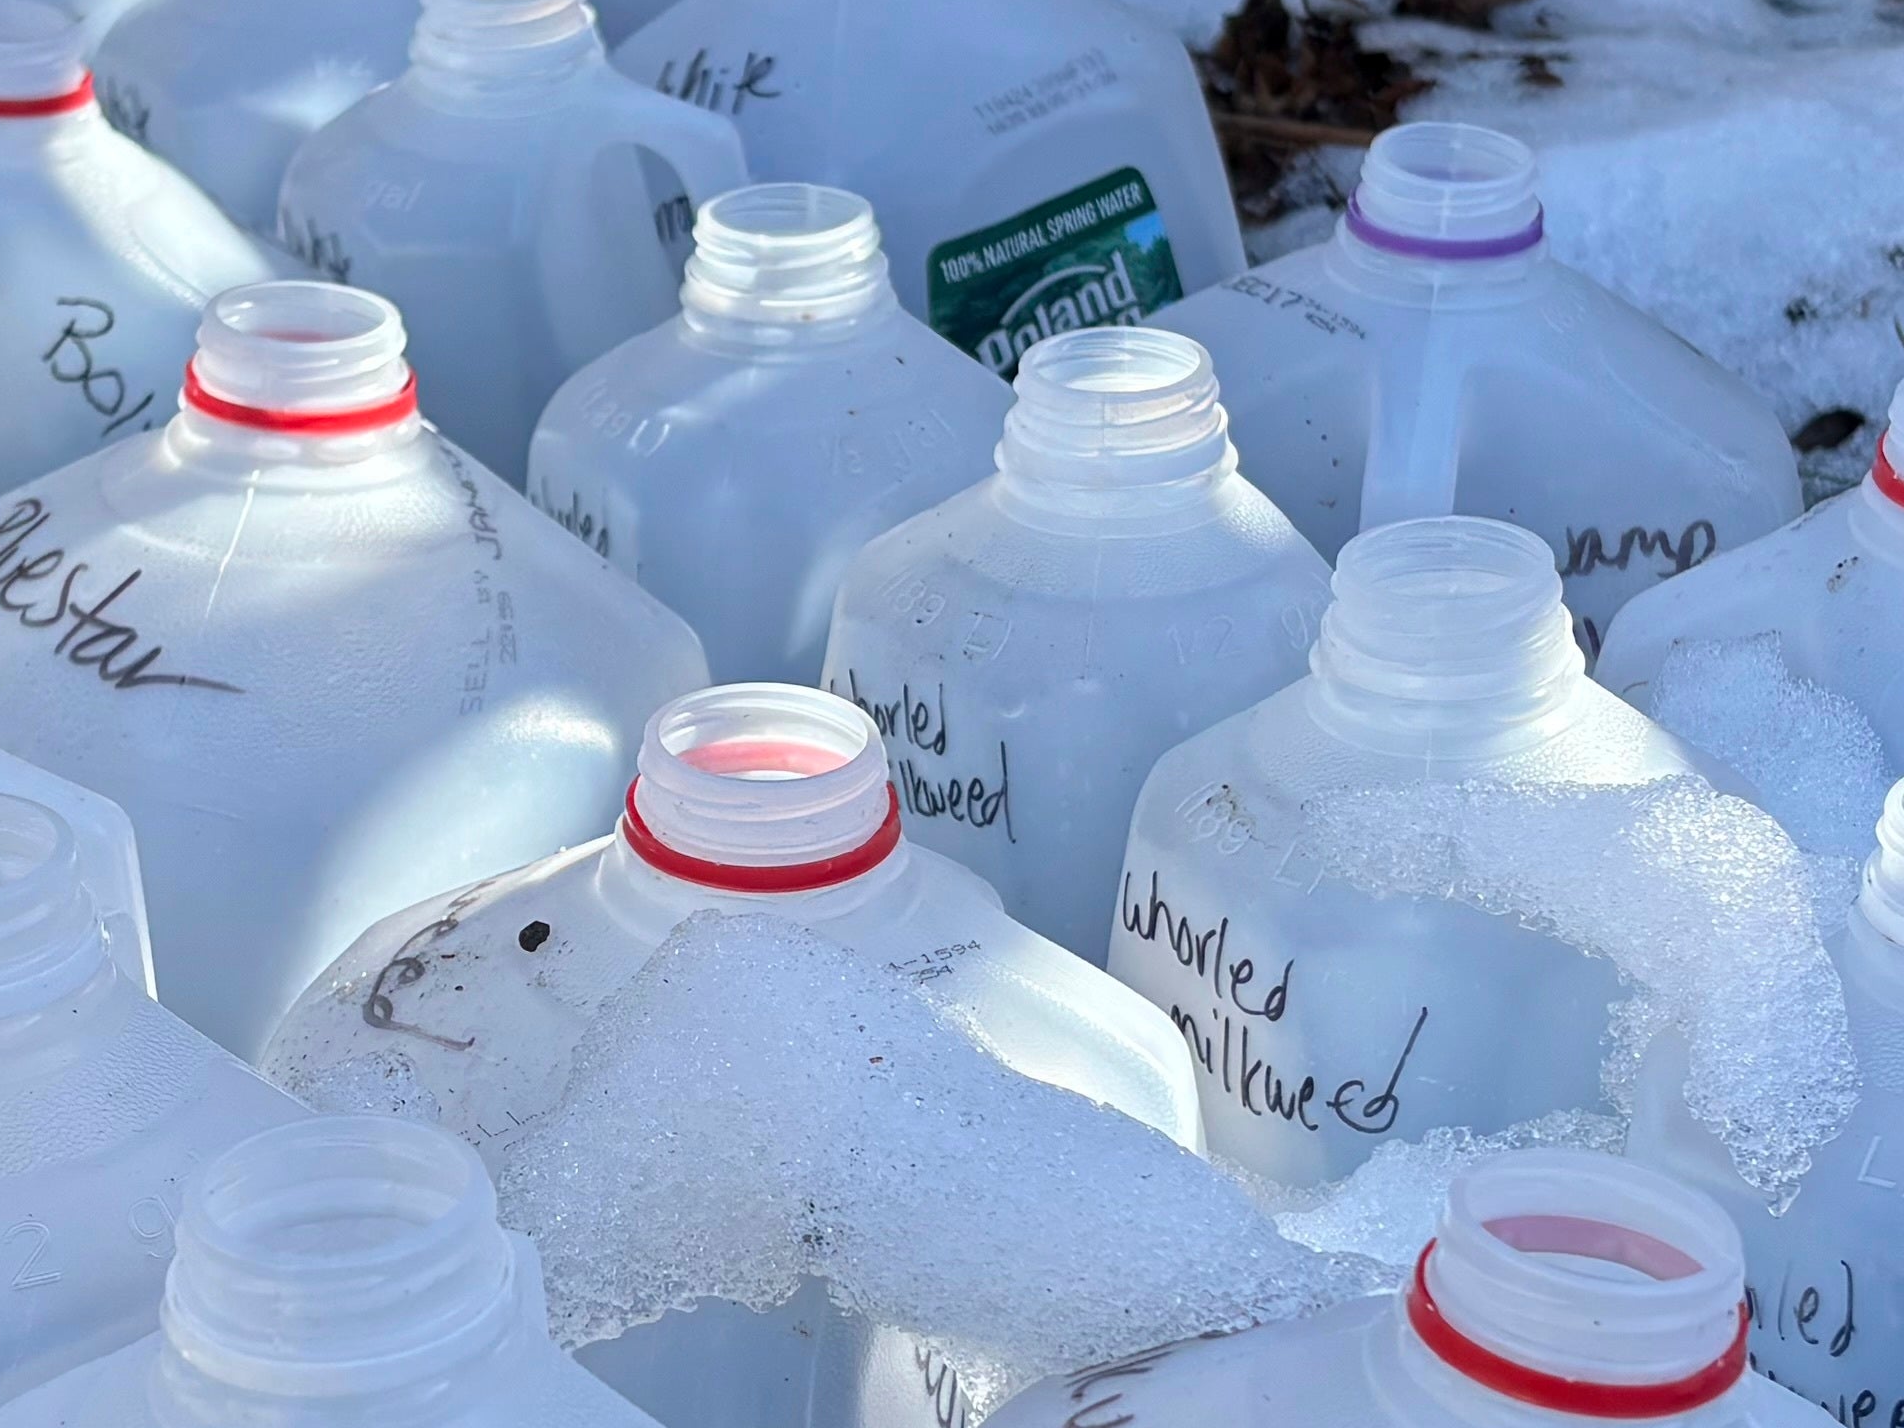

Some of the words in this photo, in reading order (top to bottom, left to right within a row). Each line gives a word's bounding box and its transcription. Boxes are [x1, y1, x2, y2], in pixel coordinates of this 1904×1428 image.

[939, 248, 983, 286] 100%
[983, 220, 1048, 269] NATURAL
[1045, 200, 1097, 243] SPRING
[1094, 179, 1146, 221] WATER
